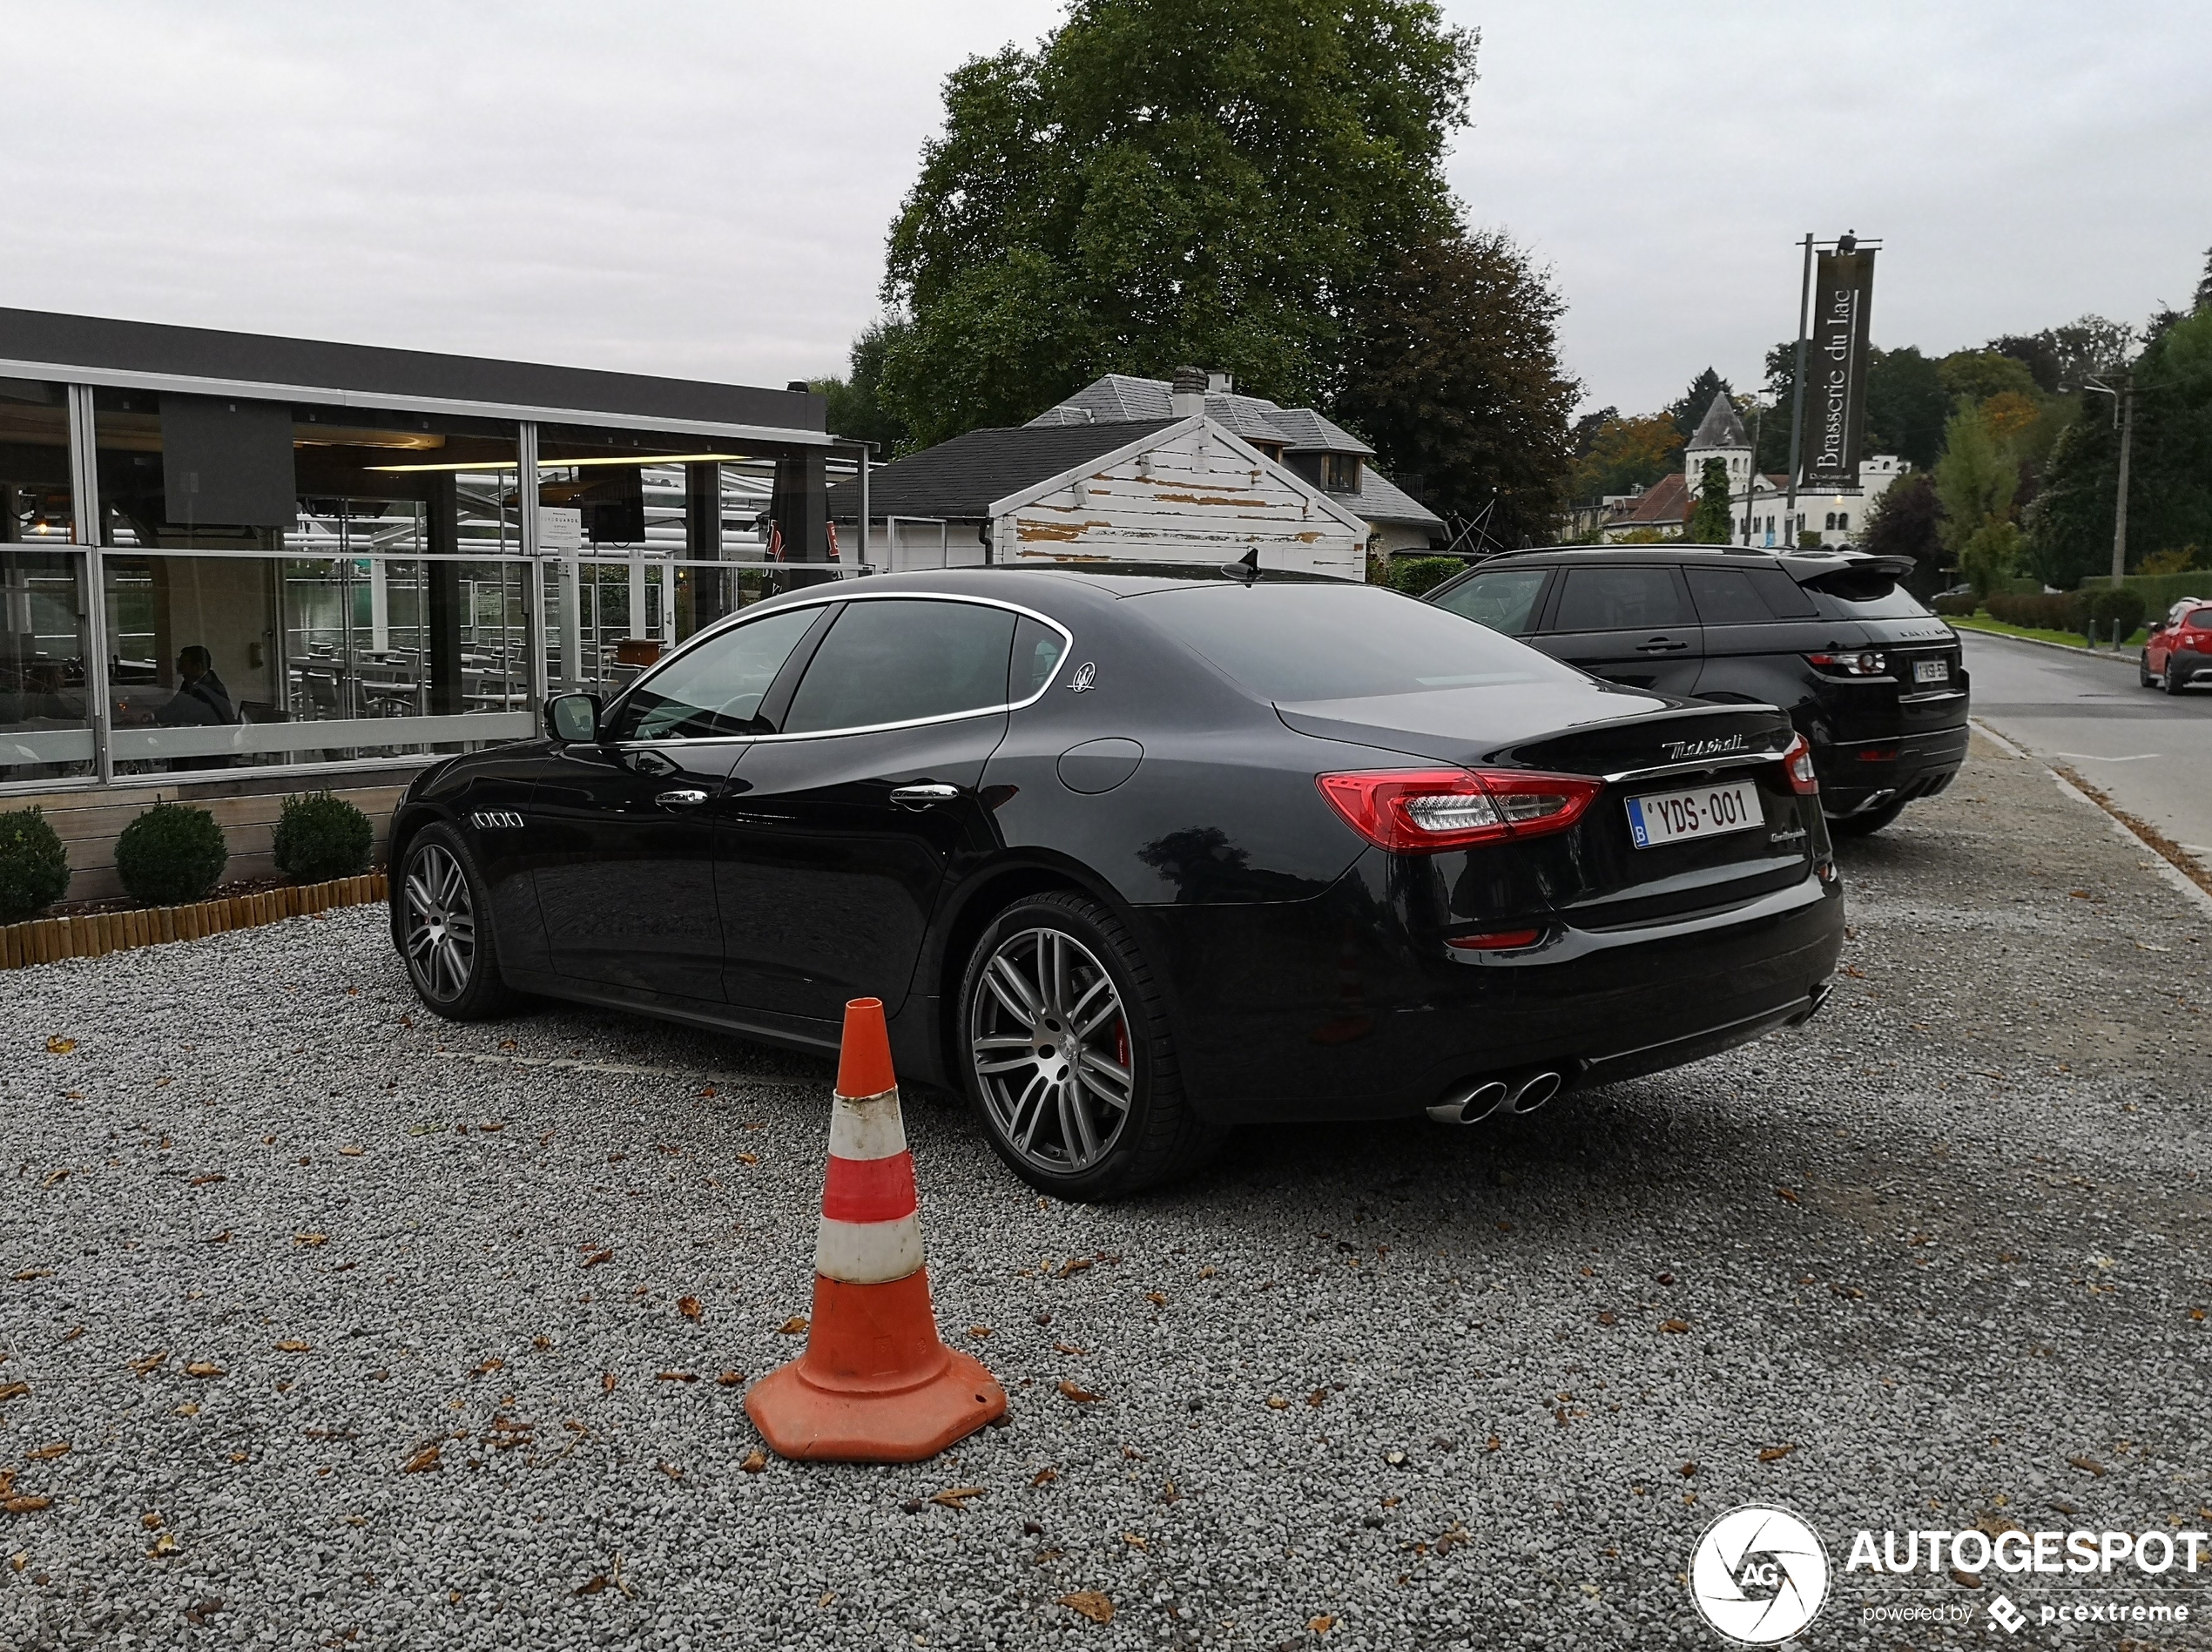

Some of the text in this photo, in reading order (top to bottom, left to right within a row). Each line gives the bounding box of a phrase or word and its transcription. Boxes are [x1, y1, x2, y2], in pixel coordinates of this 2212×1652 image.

[1826, 289, 1851, 326] Lac
[1824, 334, 1848, 361] du
[1817, 369, 1845, 468] Brasserie
[1662, 734, 1750, 759] Maserati
[1657, 789, 1747, 835] YDS-001
[1635, 826, 1646, 842] B
